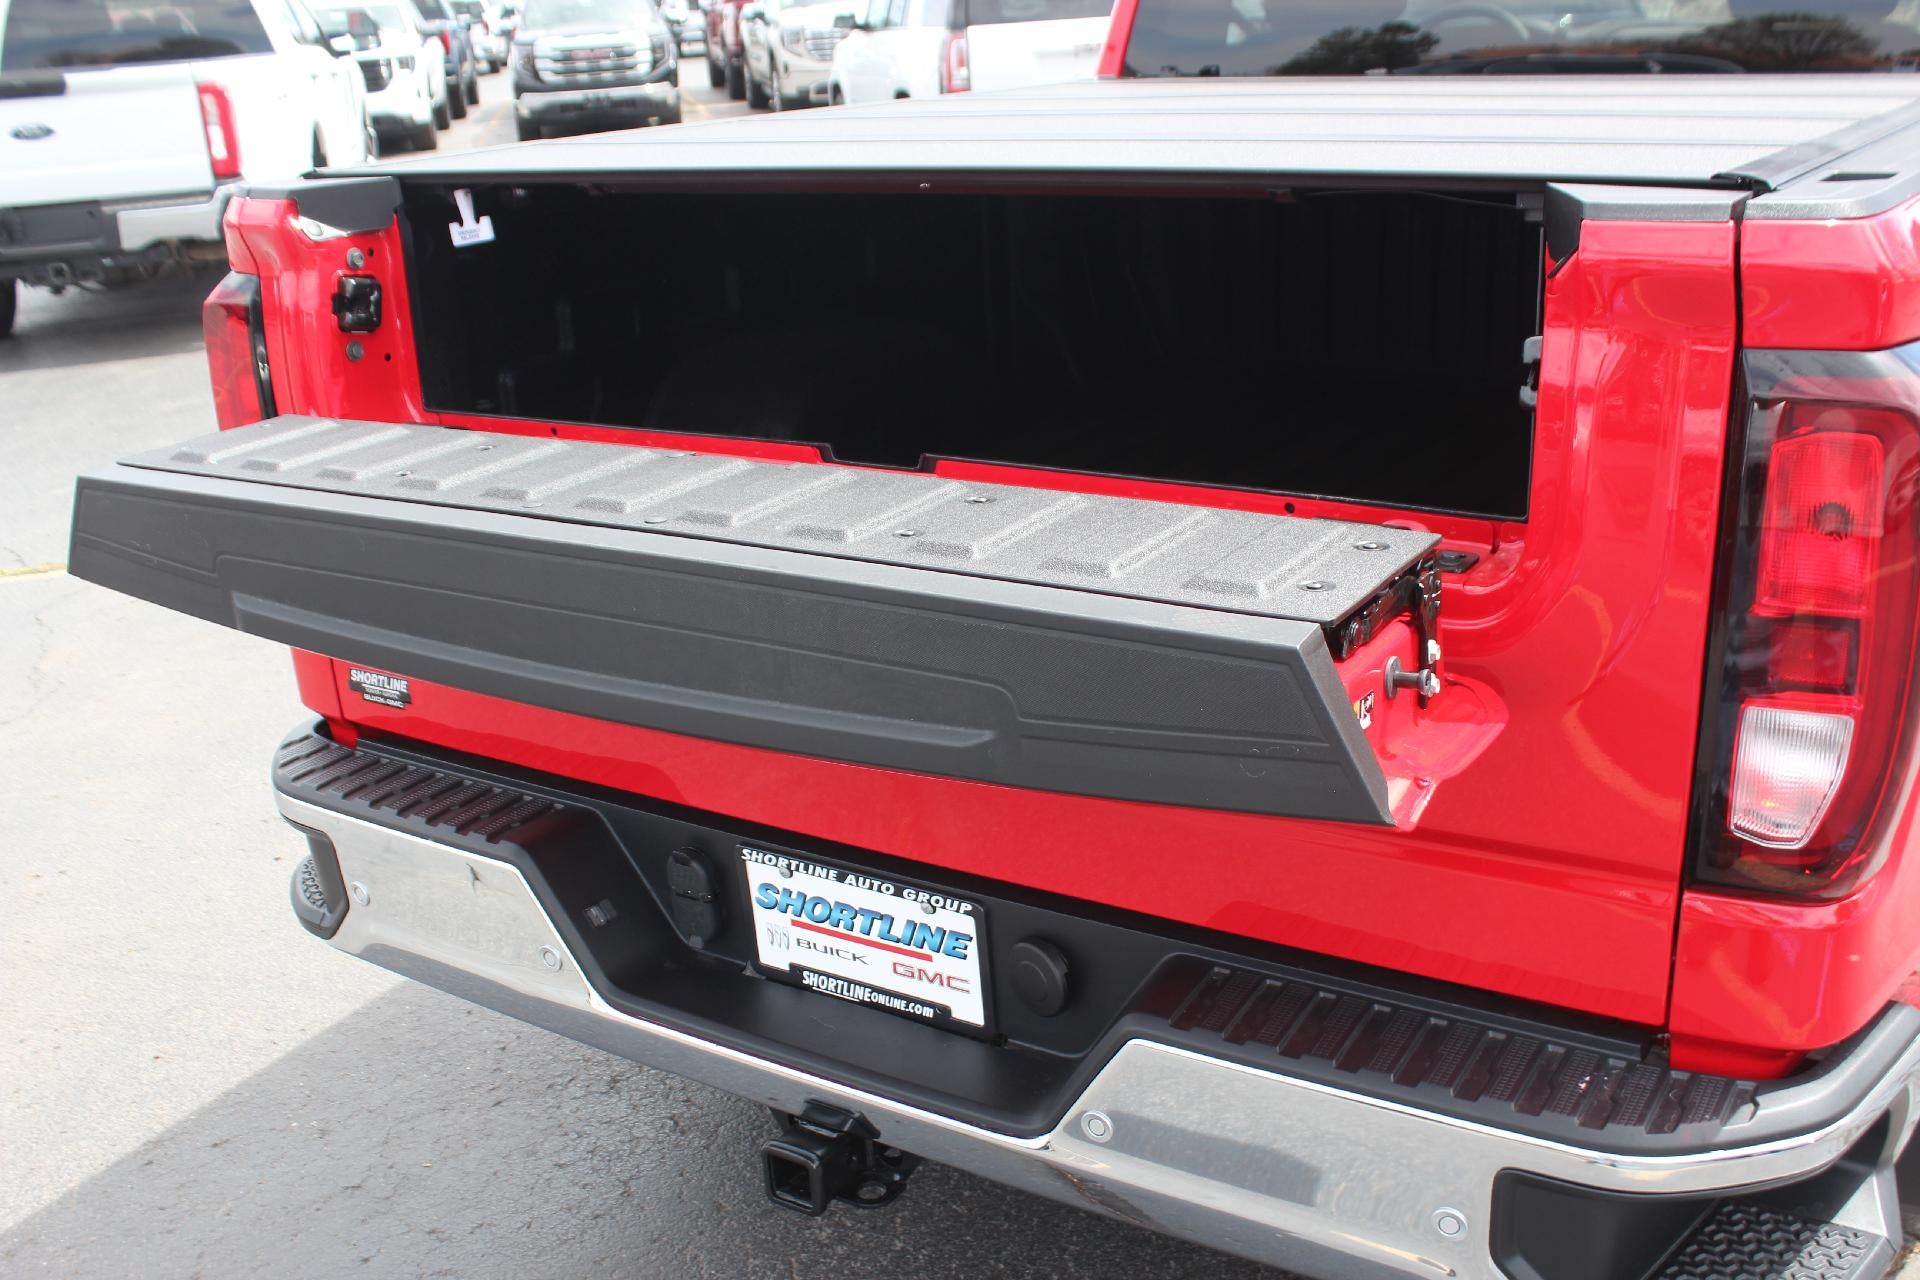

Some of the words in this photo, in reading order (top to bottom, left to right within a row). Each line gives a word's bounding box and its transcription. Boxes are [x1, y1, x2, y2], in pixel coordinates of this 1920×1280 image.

[350, 669, 408, 693] SHORTLINE
[741, 848, 838, 881] SHORTLINE
[844, 873, 895, 896] AUTO
[902, 888, 973, 914] GROUP
[755, 882, 973, 960] SHORTLINE
[796, 937, 869, 965] BUICK
[892, 962, 970, 994] GMC
